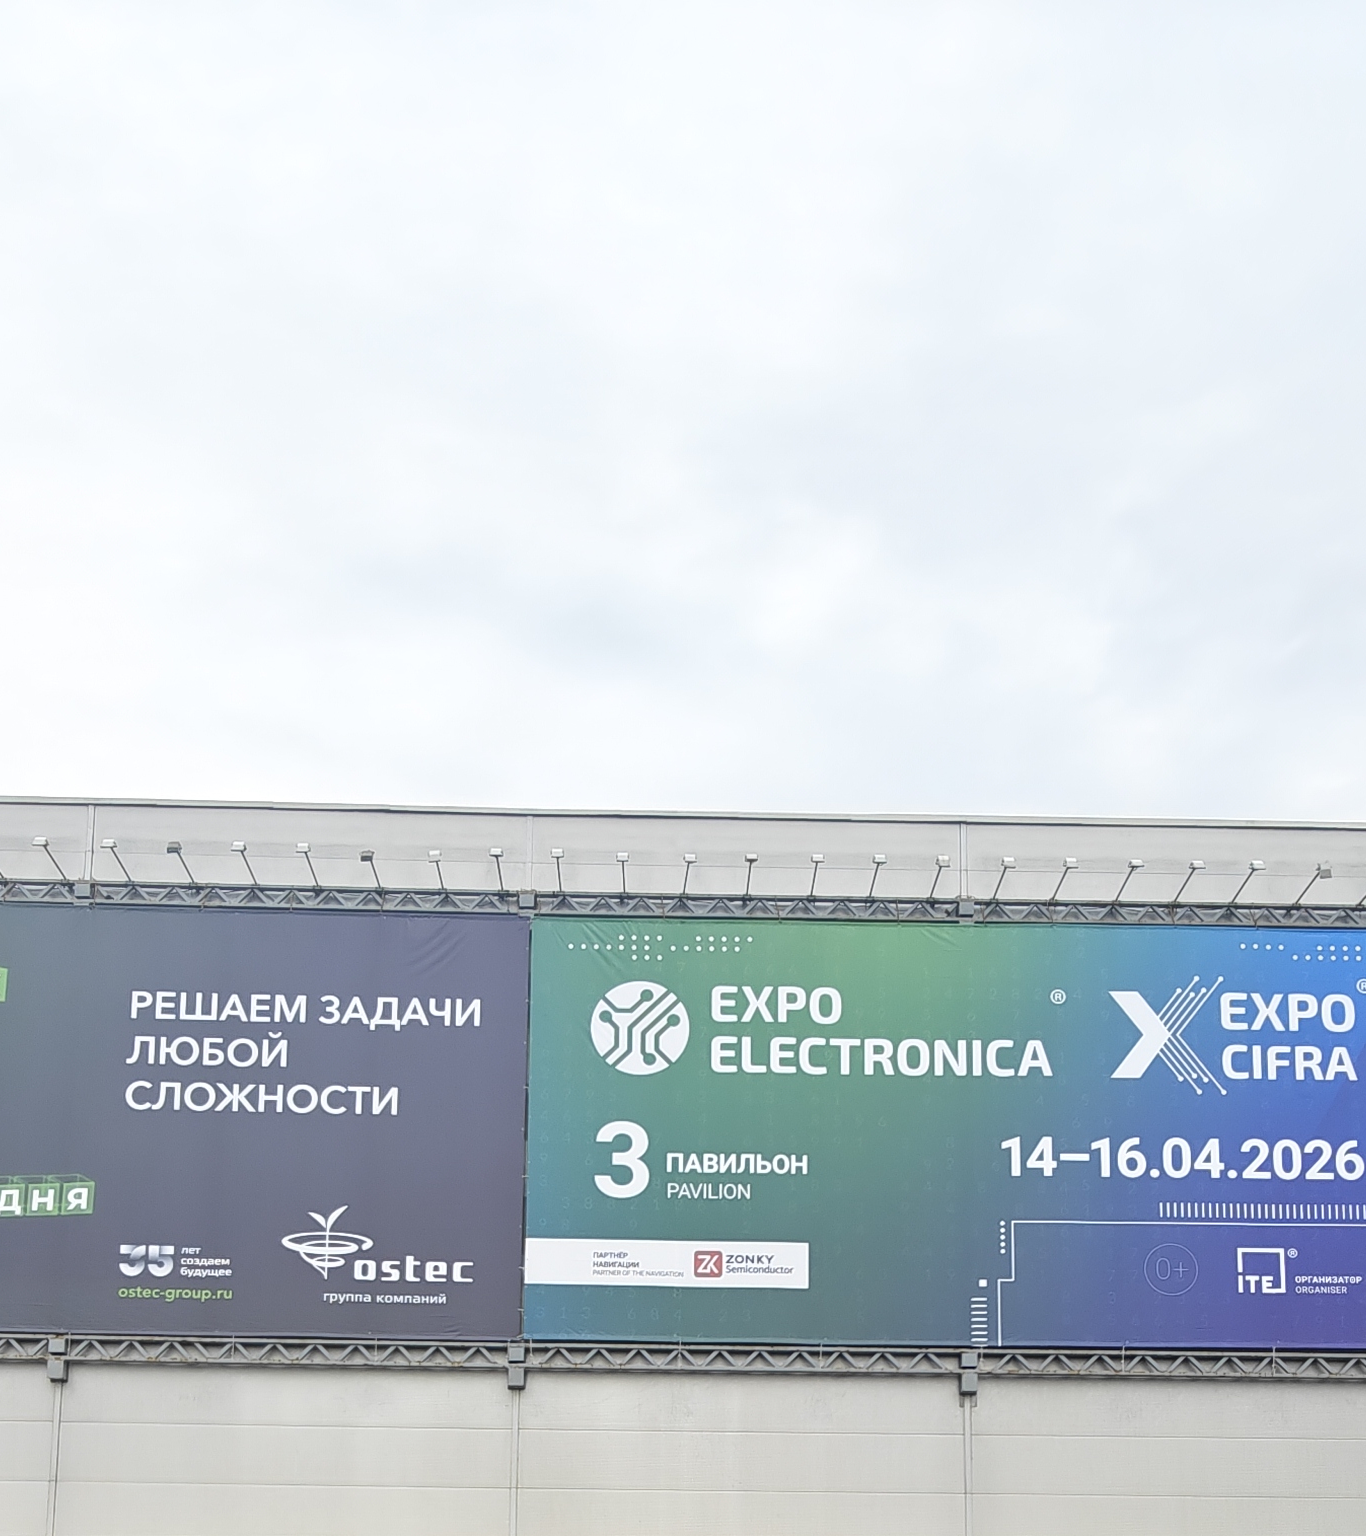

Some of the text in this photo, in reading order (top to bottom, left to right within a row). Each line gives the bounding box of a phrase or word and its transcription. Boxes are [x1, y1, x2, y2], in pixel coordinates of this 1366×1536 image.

[130, 991, 481, 1031] РЕШАЕМ ЗАДАЧИ
[711, 985, 842, 1024] EXPO
[1220, 991, 1355, 1032] EXPO
[126, 1032, 288, 1067] ЛЮБОЙ
[710, 1036, 1053, 1077] ELECTRONICA
[1222, 1044, 1358, 1081] CIFRA
[125, 1081, 398, 1115] СЛОЖНОСТИ
[594, 1120, 650, 1199] 3
[666, 1151, 808, 1175] ПАВИЛЬОН
[666, 1183, 751, 1200] PAVILION
[119, 1244, 174, 1277] 35
[180, 1257, 231, 1267] создаем
[592, 1251, 628, 1259] ПАРТНЁР
[592, 1261, 639, 1269] НАВИГАЦИИ
[725, 1254, 774, 1264] ZONKY
[180, 1267, 233, 1278] будущее
[353, 1255, 474, 1283] ostec
[725, 1265, 794, 1275] Semiconductor
[1155, 1258, 1189, 1280] 0+
[1295, 1275, 1362, 1284] ОРГАНИЗАТОР
[118, 1286, 233, 1302] ostec-group.ru
[323, 1291, 447, 1304] группа компаний
[1295, 1286, 1347, 1294] ORGANISER
